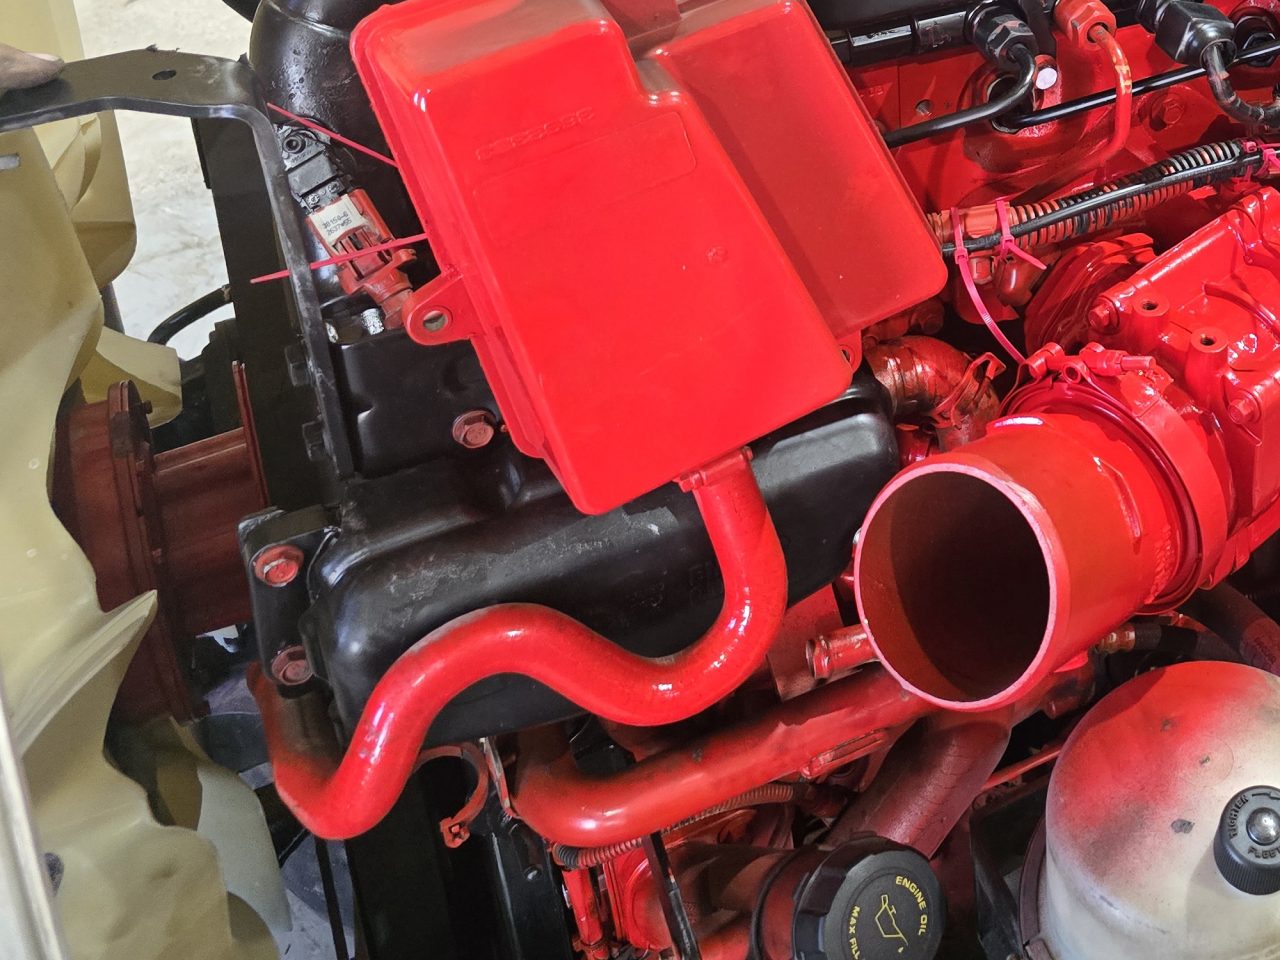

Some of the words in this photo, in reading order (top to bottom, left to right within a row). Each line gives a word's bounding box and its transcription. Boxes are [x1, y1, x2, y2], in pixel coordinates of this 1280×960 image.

[1228, 794, 1249, 839] TIGHTER
[848, 905, 861, 934] MAX
[895, 875, 928, 911] ENGINE
[918, 914, 928, 936] OIL
